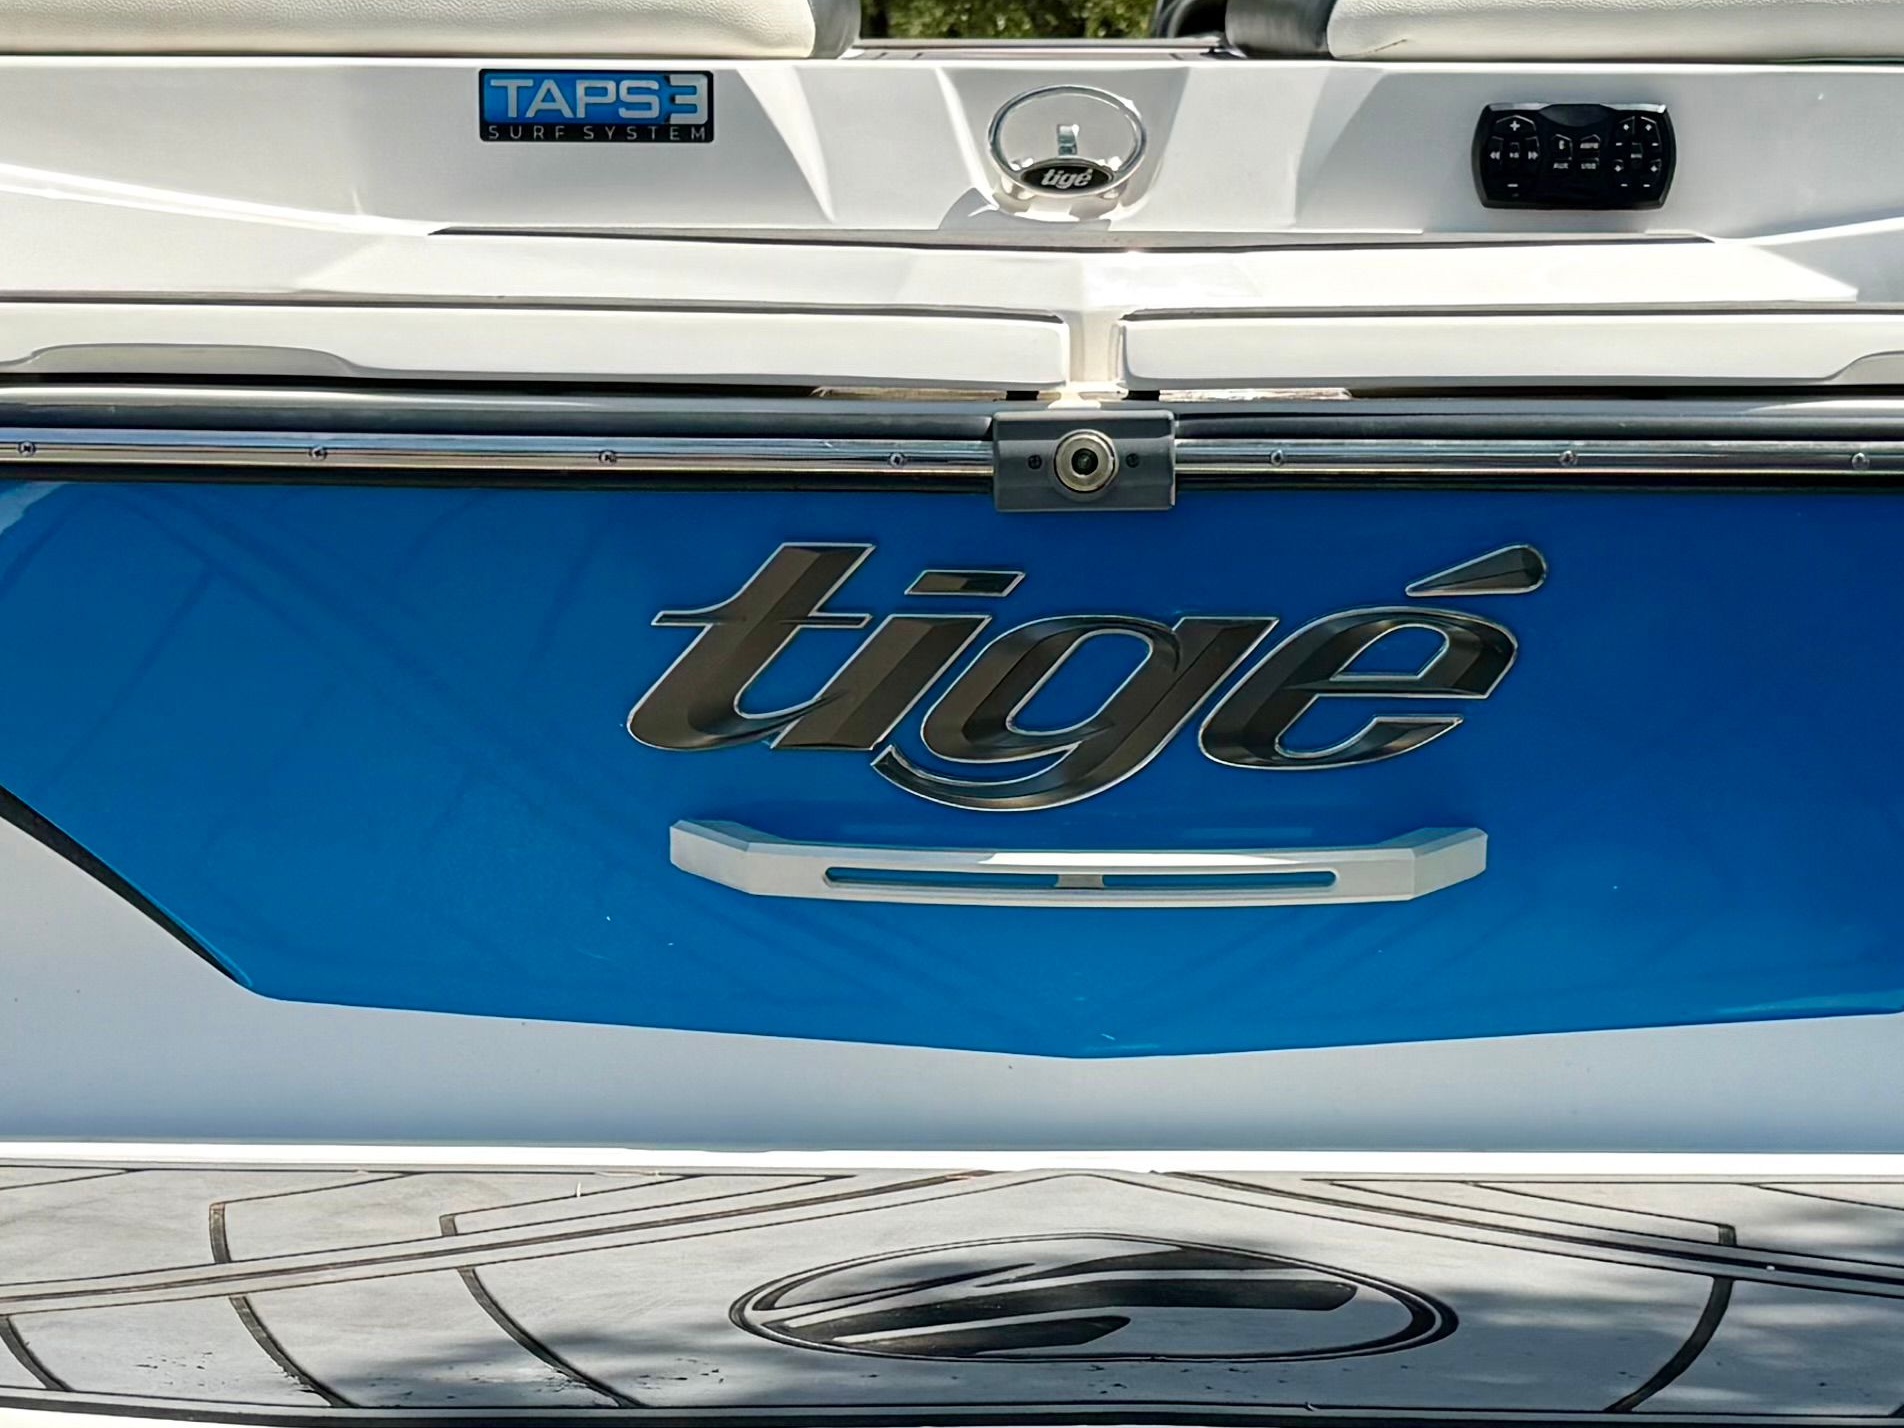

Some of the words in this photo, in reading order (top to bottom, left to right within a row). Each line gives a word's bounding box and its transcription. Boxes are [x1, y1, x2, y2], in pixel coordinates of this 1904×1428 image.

[488, 125, 565, 140] SURF
[583, 125, 706, 141] SYSTEM
[1041, 169, 1094, 189] tigé
[626, 542, 1548, 812] tigé
